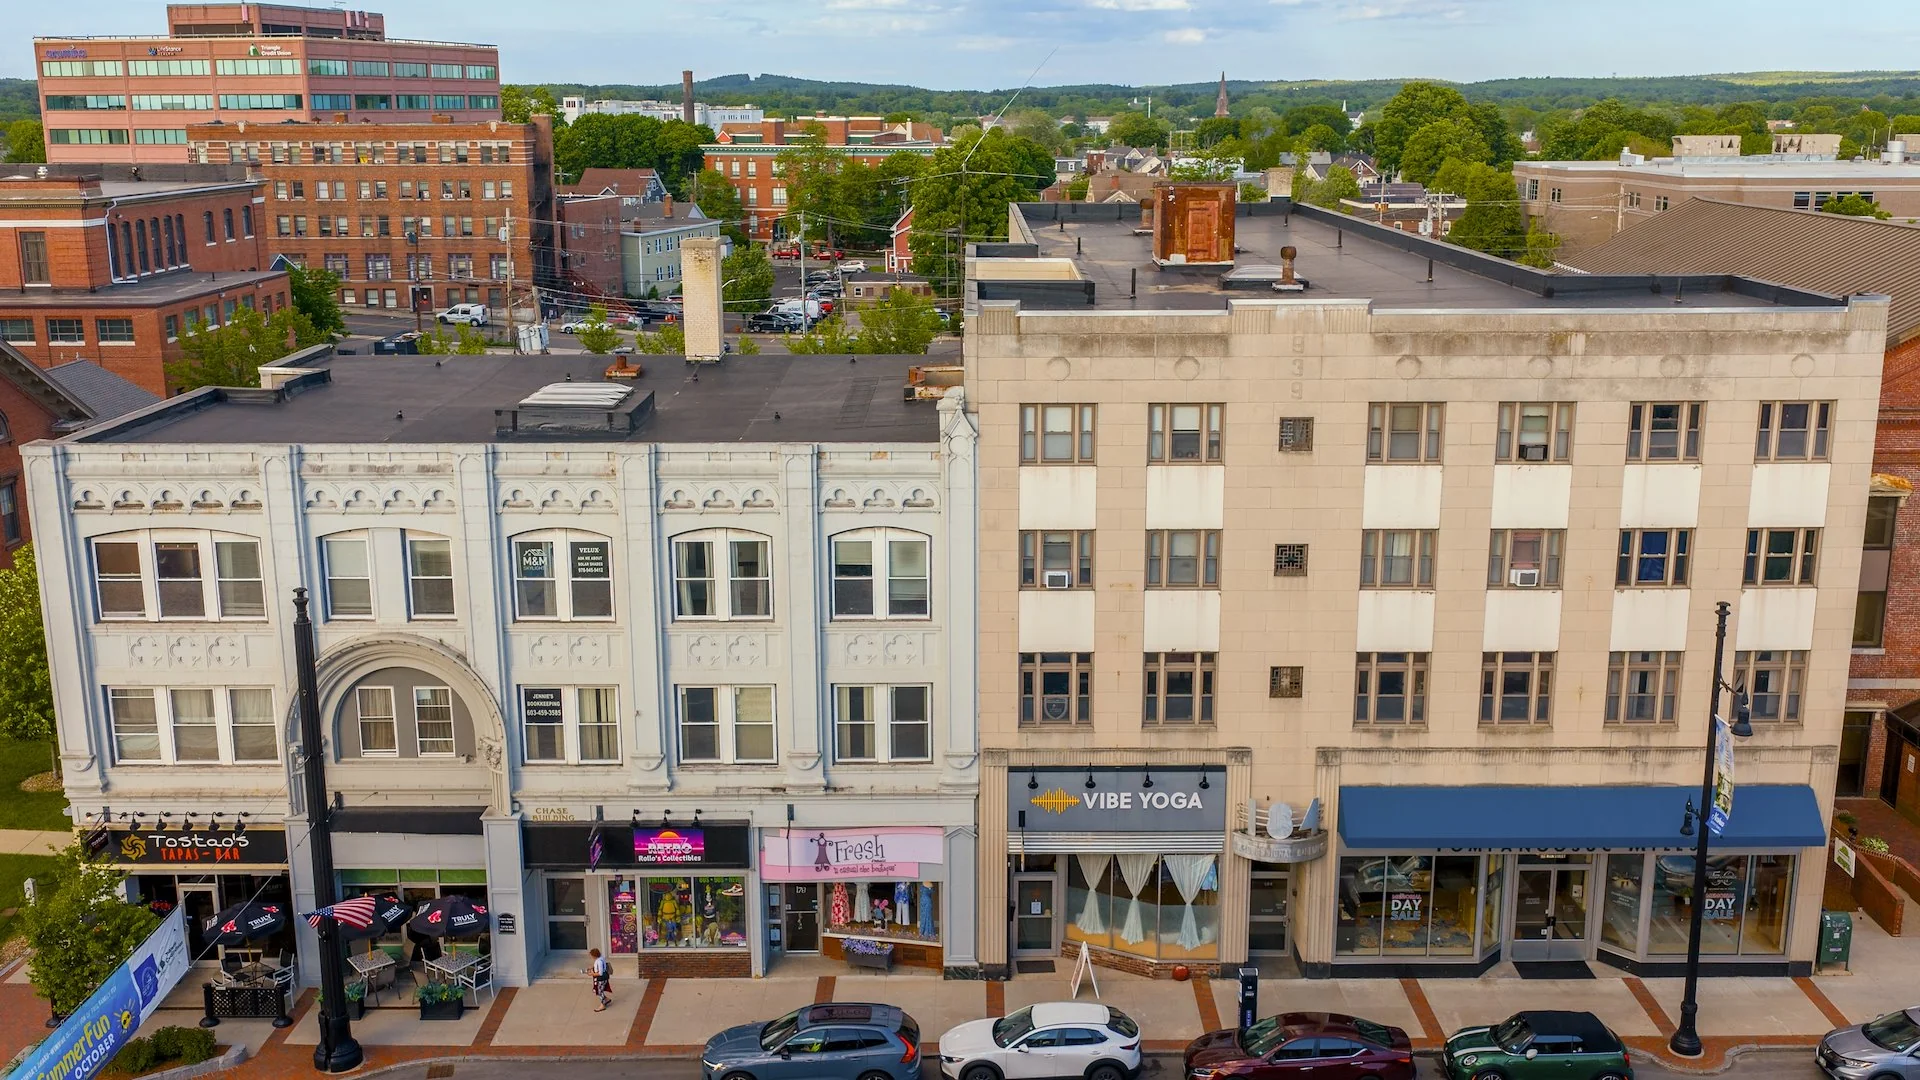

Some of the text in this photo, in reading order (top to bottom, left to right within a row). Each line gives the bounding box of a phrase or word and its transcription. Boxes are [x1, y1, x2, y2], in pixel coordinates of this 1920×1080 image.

[523, 557, 548, 566] M&M
[1083, 792, 1203, 809] VIBE YOGA
[535, 807, 569, 815] CHASE
[532, 814, 576, 822] BUILDING
[648, 843, 693, 855] RETRO
[835, 834, 885, 862] Fresh
[161, 848, 199, 861] TAPAS
[215, 848, 240, 860] BAR
[1391, 900, 1422, 910] DAY
[1705, 899, 1736, 909] DAY
[381, 905, 400, 919] TRULY
[451, 912, 475, 923] TRULY
[1391, 910, 1421, 920] SALE
[1704, 909, 1735, 919] SALE
[248, 913, 272, 927] TRULY
[74, 1033, 116, 1079] OCTOBER
